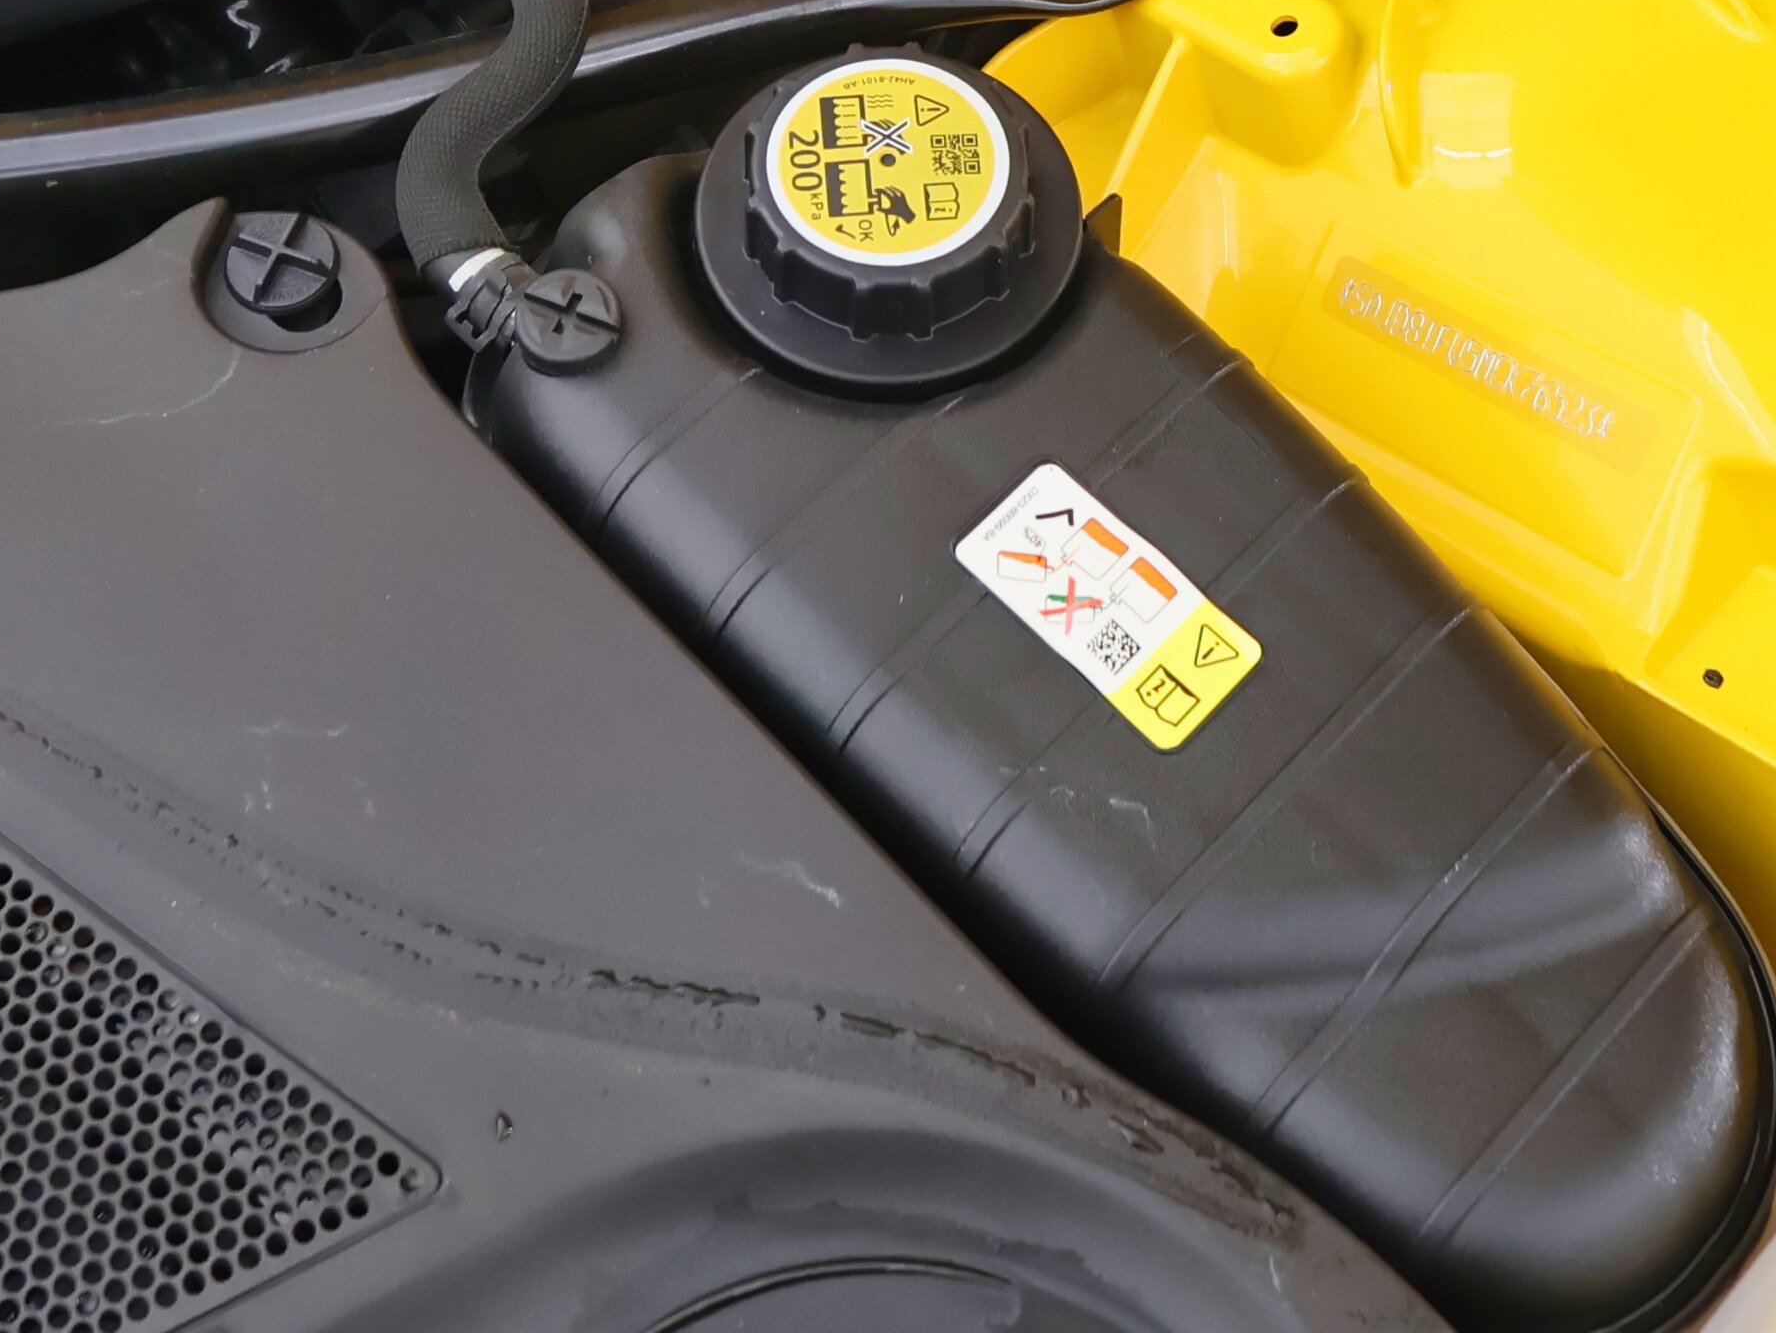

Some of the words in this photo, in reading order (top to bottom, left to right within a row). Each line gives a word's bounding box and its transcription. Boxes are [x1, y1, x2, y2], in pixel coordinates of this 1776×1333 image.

[788, 129, 823, 192] 200
[809, 192, 824, 221] kPa
[857, 218, 875, 243] OK
